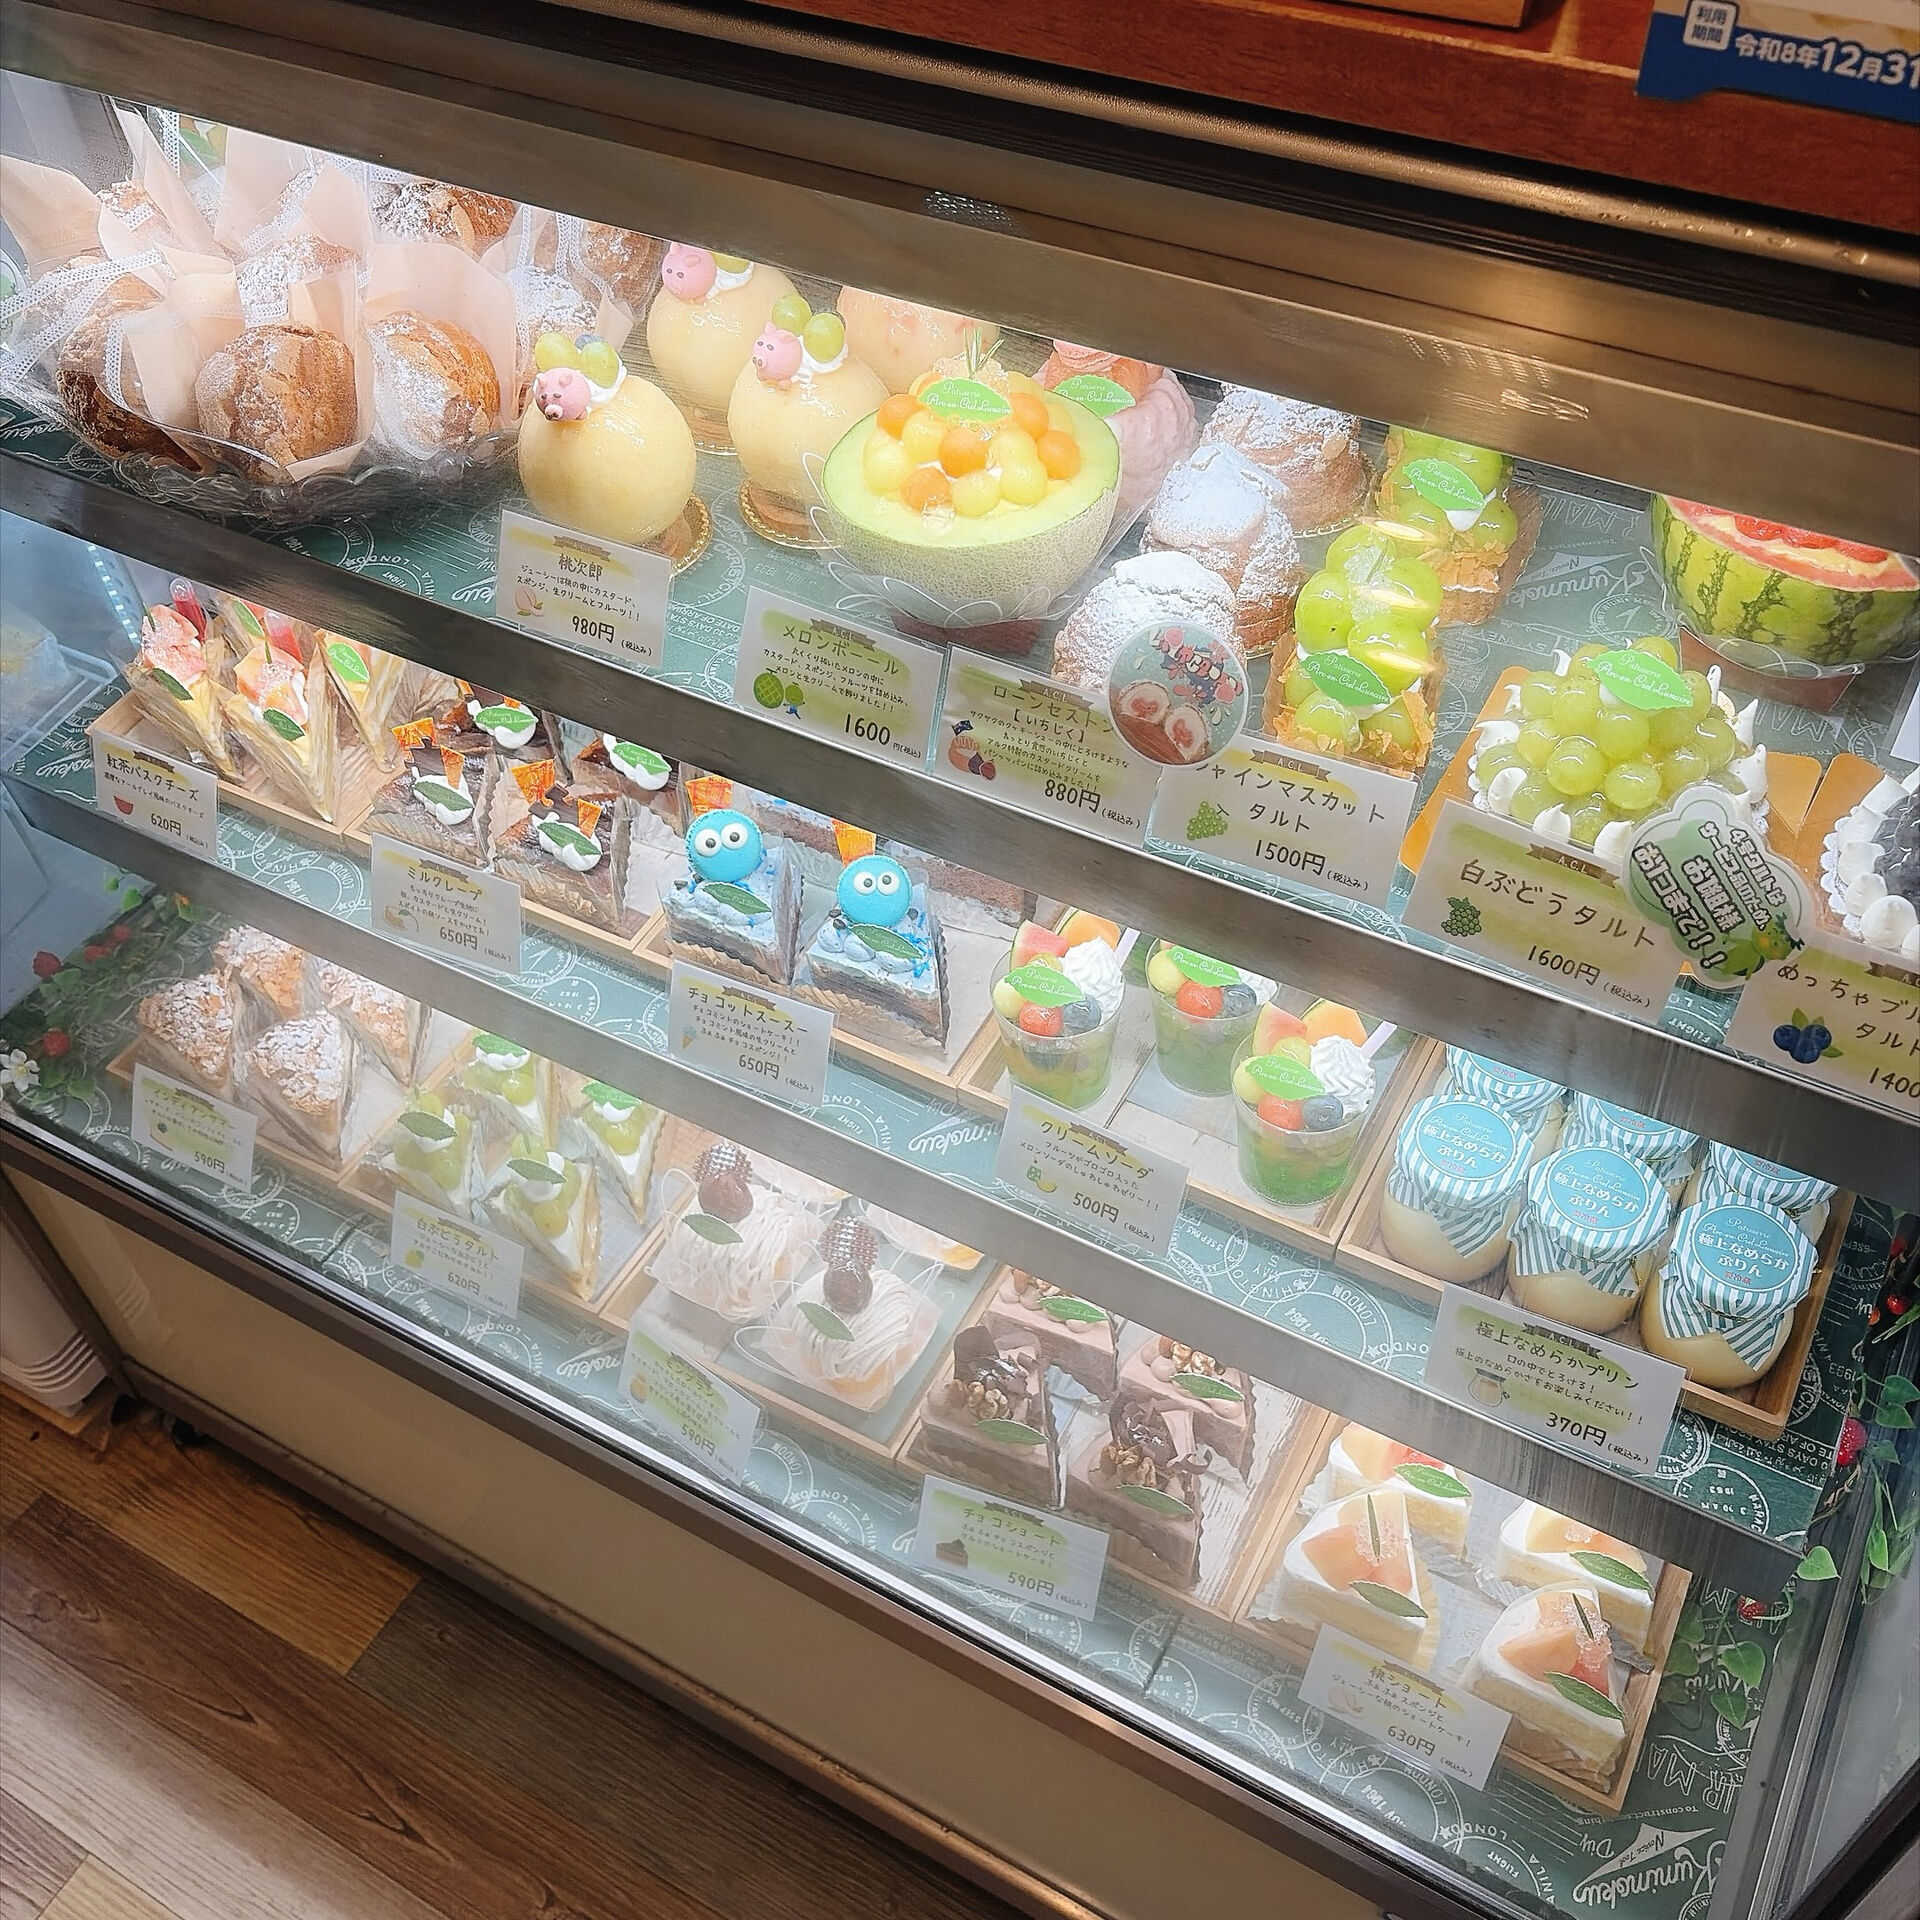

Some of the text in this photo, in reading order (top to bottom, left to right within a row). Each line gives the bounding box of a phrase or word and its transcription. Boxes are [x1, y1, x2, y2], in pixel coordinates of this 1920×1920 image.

[1696, 5, 1727, 25] 利用
[1690, 25, 1724, 44] 期間
[558, 553, 603, 582] 桃次郎
[1503, 559, 1649, 608] Kumimok
[572, 615, 615, 644] 980円
[106, 753, 200, 801] 紅茶バスクチーズ
[1044, 778, 1101, 814] 880円
[150, 813, 182, 837] 620円
[1249, 802, 1311, 834] タルト
[1255, 838, 1369, 892] 1500円 (税込み)
[1729, 828, 1787, 908] 4号タルトは
[407, 866, 483, 901] ミルクレープ
[1460, 858, 1655, 949] 白ぶどうタルト
[439, 926, 478, 951] 650円
[1527, 945, 1651, 1009] 1600円 (税込み)
[688, 987, 809, 1035] チョコットスースー
[738, 1054, 781, 1081] 650円
[1041, 1120, 1154, 1180] クリームソーダ
[1422, 1124, 1506, 1164] 極上なめらか
[1436, 1145, 1477, 1169] ぷりん
[194, 1151, 226, 1174] 590円
[1072, 1191, 1120, 1224] 500円
[1554, 1171, 1639, 1213] 極上なめらか
[1568, 1193, 1610, 1219] ぷりん
[1698, 1232, 1790, 1271] 極上なめらか
[1717, 1254, 1763, 1278] ぷりん
[448, 1271, 481, 1296] 620円
[1475, 1320, 1641, 1391] 極上なめらかプリン
[681, 1423, 716, 1457] 590円
[1545, 1411, 1608, 1448] 370円
[1607, 1441, 1650, 1466] (税込み)
[963, 1507, 1061, 1548] チョコショート
[1007, 1570, 1056, 1598] 590円
[1368, 1664, 1447, 1710] 桃ショート
[1387, 1724, 1436, 1757] 630円
[1575, 1833, 1615, 1859] Diy
[1571, 1839, 1727, 1910] Kumimoku
